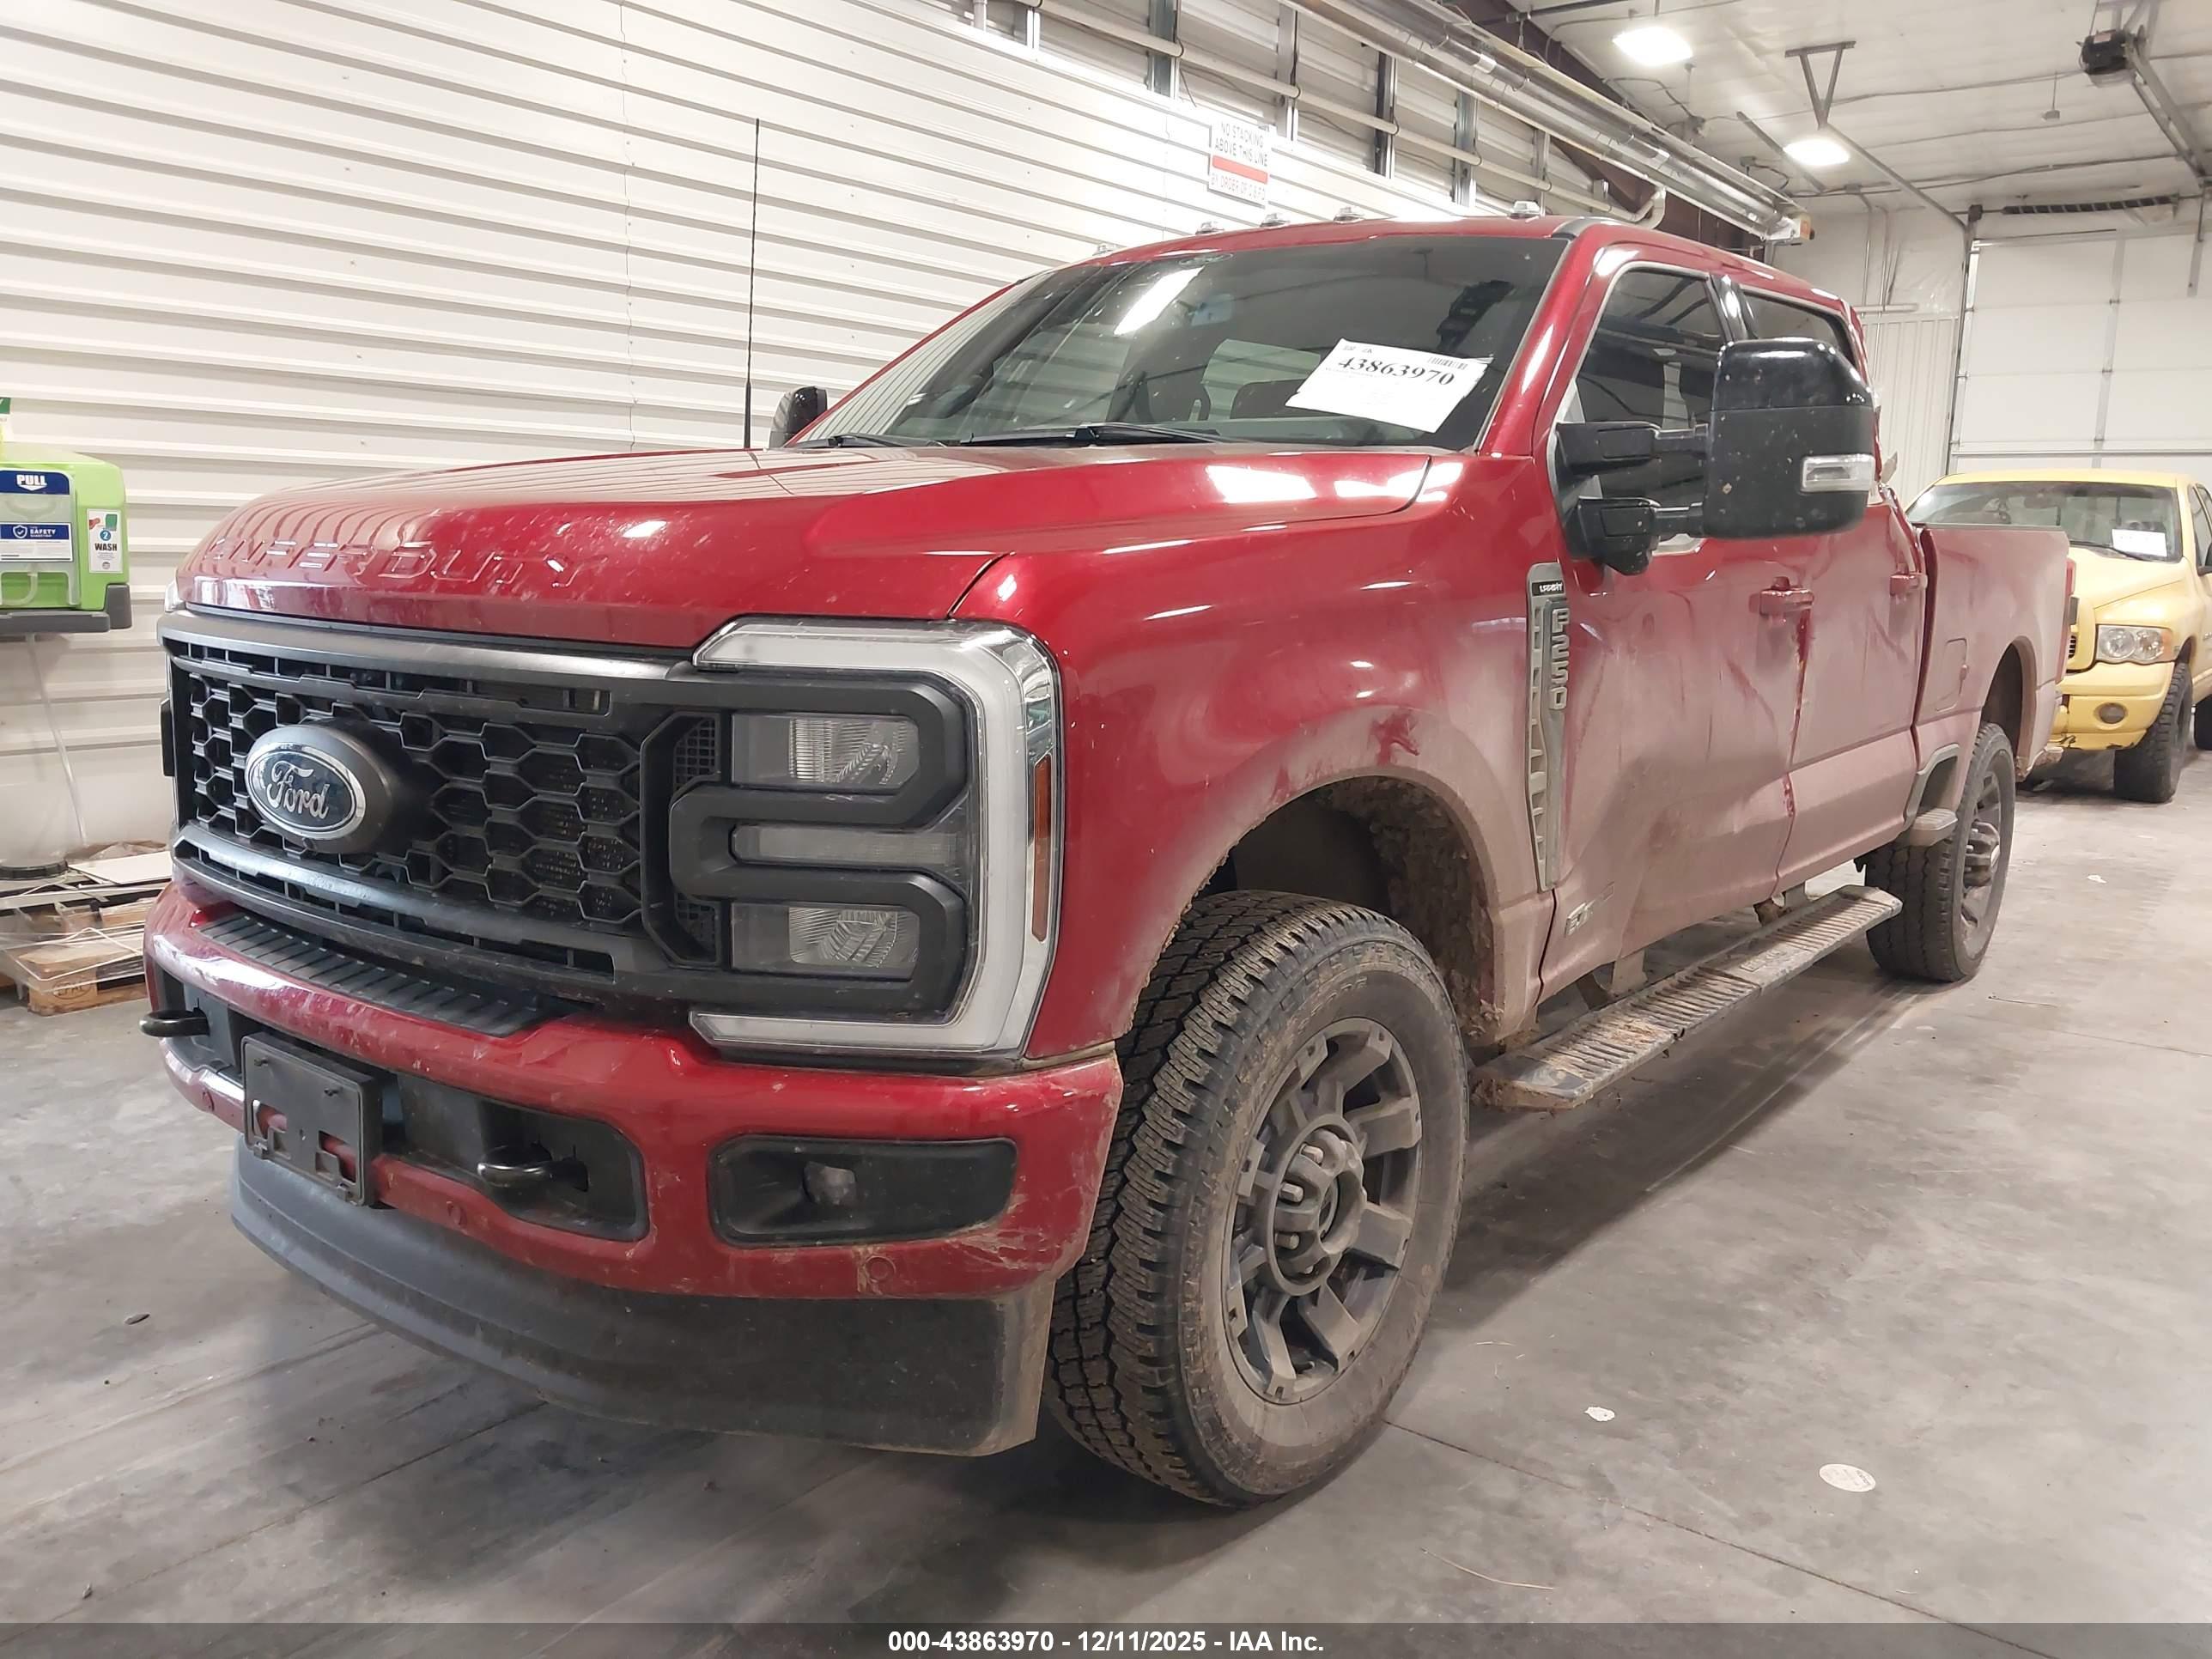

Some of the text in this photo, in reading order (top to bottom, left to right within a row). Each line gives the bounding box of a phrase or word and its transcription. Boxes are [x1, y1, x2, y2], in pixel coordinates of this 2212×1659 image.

[1221, 121, 1264, 148] NO STACKING
[1215, 138, 1267, 167] ABOVE THIS LINE
[1338, 356, 1455, 386] 43863970
[16, 474, 47, 486] PULL
[94, 543, 118, 551] WASH
[102, 531, 109, 540] 2
[266, 760, 331, 819] Ford
